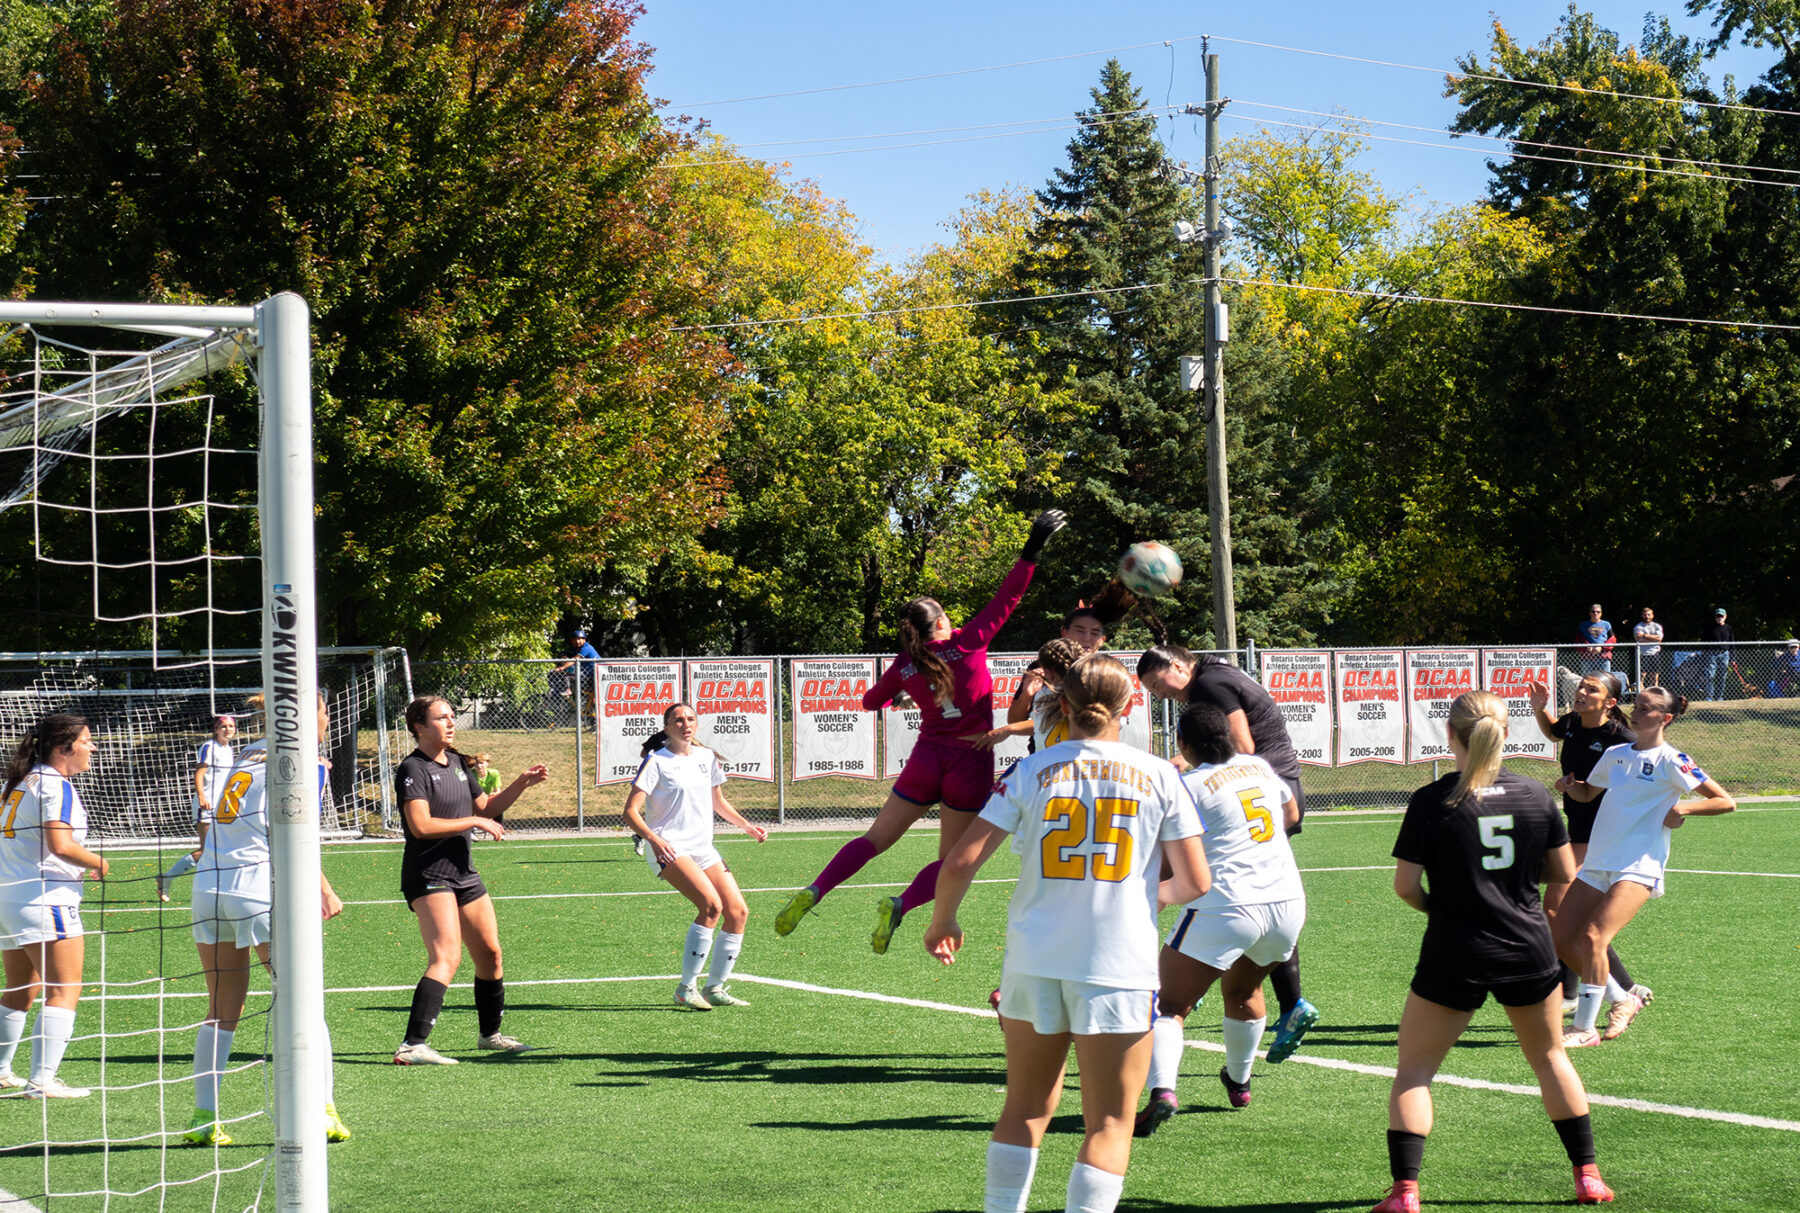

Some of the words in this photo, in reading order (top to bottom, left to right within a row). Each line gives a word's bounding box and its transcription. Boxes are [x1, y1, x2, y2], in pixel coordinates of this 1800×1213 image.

[993, 659, 1020, 667] Ontario
[1295, 655, 1320, 663] Colleges
[1488, 659, 1514, 667] Athletic
[608, 665, 636, 673] Ontario
[637, 665, 670, 674] Colleges
[700, 663, 727, 671] Ontario
[729, 663, 761, 671] Colleges
[803, 662, 830, 670] Ontario
[832, 662, 864, 670] Colleges
[1365, 661, 1399, 669] Association
[633, 673, 677, 681] Association
[725, 671, 768, 679] Association
[797, 670, 827, 678] Athletic
[828, 670, 871, 678] Association
[1343, 669, 1398, 689] OCAA
[1414, 668, 1472, 687] OCAA
[1490, 667, 1549, 687] OCAA
[1269, 670, 1325, 690] OCAA
[272, 631, 300, 755] KWIKGOAL
[605, 681, 675, 702] OCAA
[696, 680, 765, 700] OCAA
[801, 678, 868, 699] OCAA
[1342, 688, 1399, 703] CHAMPIONS
[605, 702, 676, 717] CHAMPION
[696, 700, 767, 715] CHAMPIONS
[800, 699, 870, 713] CHAMPION
[1360, 703, 1385, 711] MEN'S
[716, 715, 747, 724] MEN'S
[814, 714, 858, 722] WOMEN'S
[1357, 712, 1386, 720] SOCCER
[625, 718, 656, 727] MEN'S
[817, 723, 854, 732] SOCCER
[622, 727, 659, 736] SOCCER
[713, 725, 750, 734] SOCCER
[1350, 747, 1395, 757] 2005-2006
[808, 760, 864, 770] 1985-1986
[1037, 758, 1153, 797] THUNDERWOLVES
[216, 770, 254, 824] 8
[1235, 786, 1275, 843] 5
[1041, 796, 1140, 883] 25
[1477, 814, 1515, 871] 5
